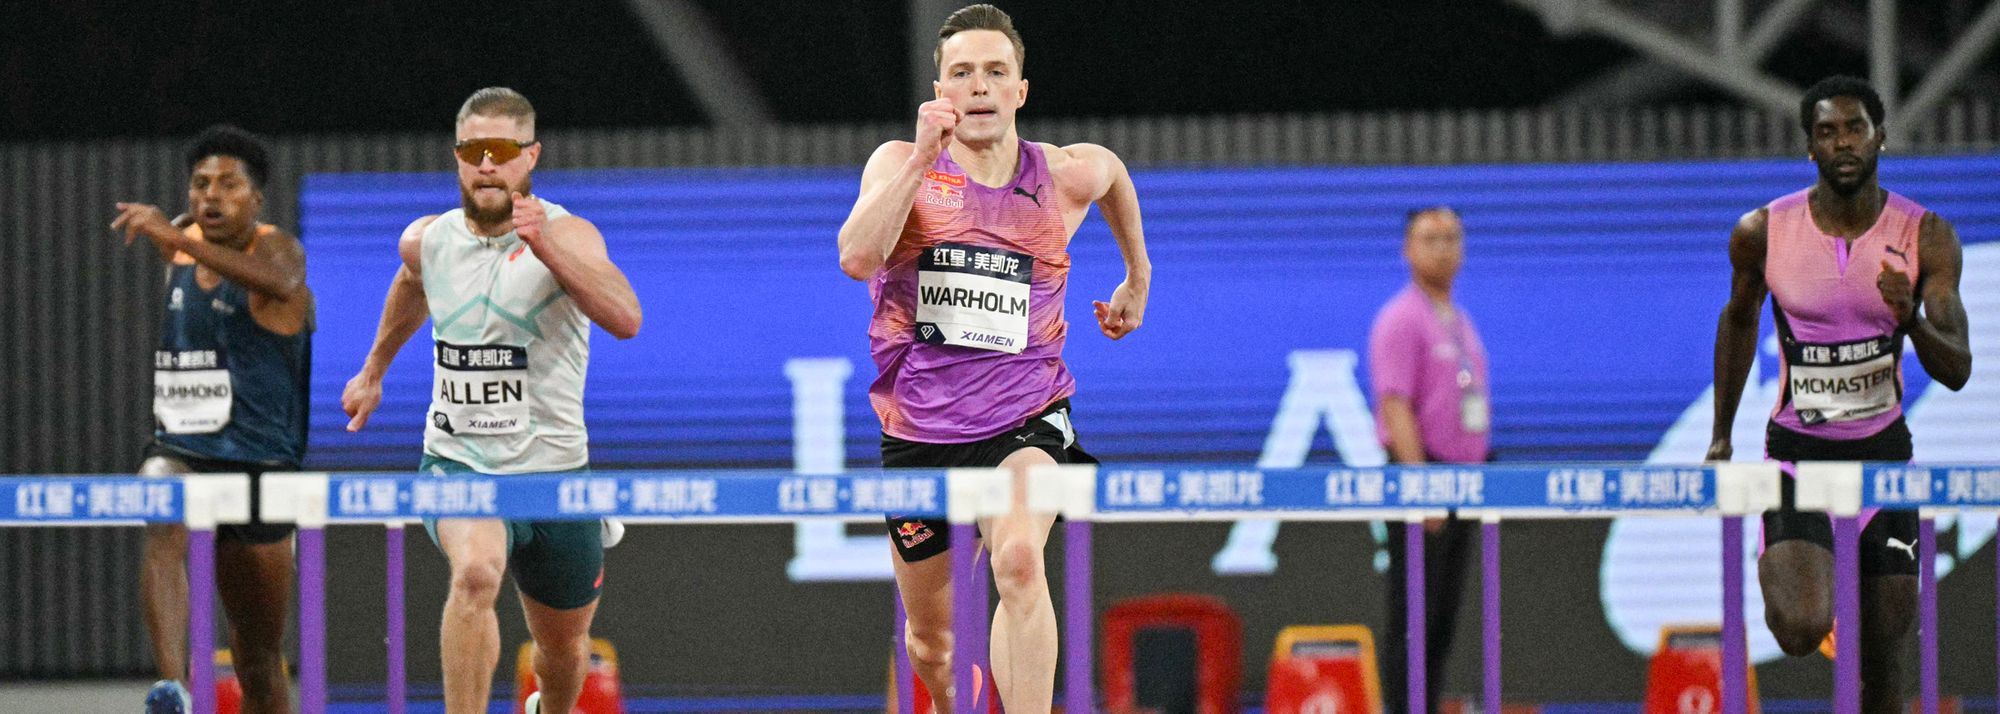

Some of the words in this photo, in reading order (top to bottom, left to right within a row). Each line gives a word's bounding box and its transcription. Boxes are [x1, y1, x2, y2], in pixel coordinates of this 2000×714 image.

[926, 193, 944, 205] Red
[945, 197, 964, 209] Bull
[933, 248, 1020, 276] 红星·美凯龙
[920, 286, 1027, 317] WARHOLM
[960, 330, 1015, 347] XIAMEN
[1802, 339, 1880, 364] 红星·美凯龙
[442, 346, 513, 367] 红星·美凯龙
[440, 378, 522, 404] ALLEN
[1794, 367, 1892, 395] MCMASTER
[468, 419, 517, 429] XIAMEN
[16, 482, 173, 517] 红星·美凯龙
[338, 479, 498, 514] 红星·美凯龙
[557, 478, 718, 513] 红星·美凯龙
[778, 477, 938, 513] 红星·美凯龙
[1105, 470, 1265, 505] 红星·美凯龙
[1326, 470, 1485, 505] 红星·美凯龙
[1547, 469, 1704, 504] 红星·美凯龙
